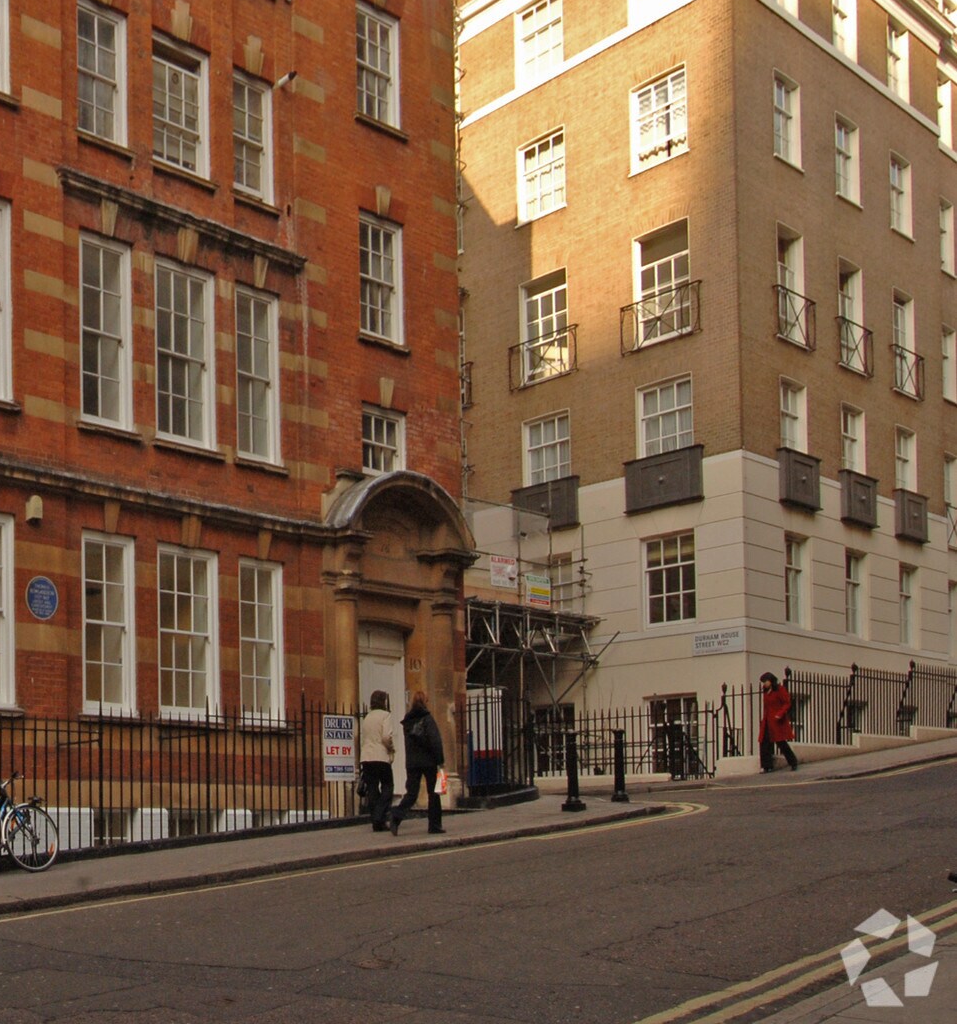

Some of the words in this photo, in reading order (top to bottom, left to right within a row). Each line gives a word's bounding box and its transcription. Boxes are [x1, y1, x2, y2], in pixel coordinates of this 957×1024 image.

[695, 634, 719, 642] DURHAM
[721, 631, 739, 639] HOUSE
[695, 640, 715, 649] STREET
[410, 658, 422, 671] 10
[325, 718, 352, 729] DRURY
[324, 730, 353, 739] ESTATES
[326, 746, 340, 755] LET
[342, 746, 352, 756] BY
